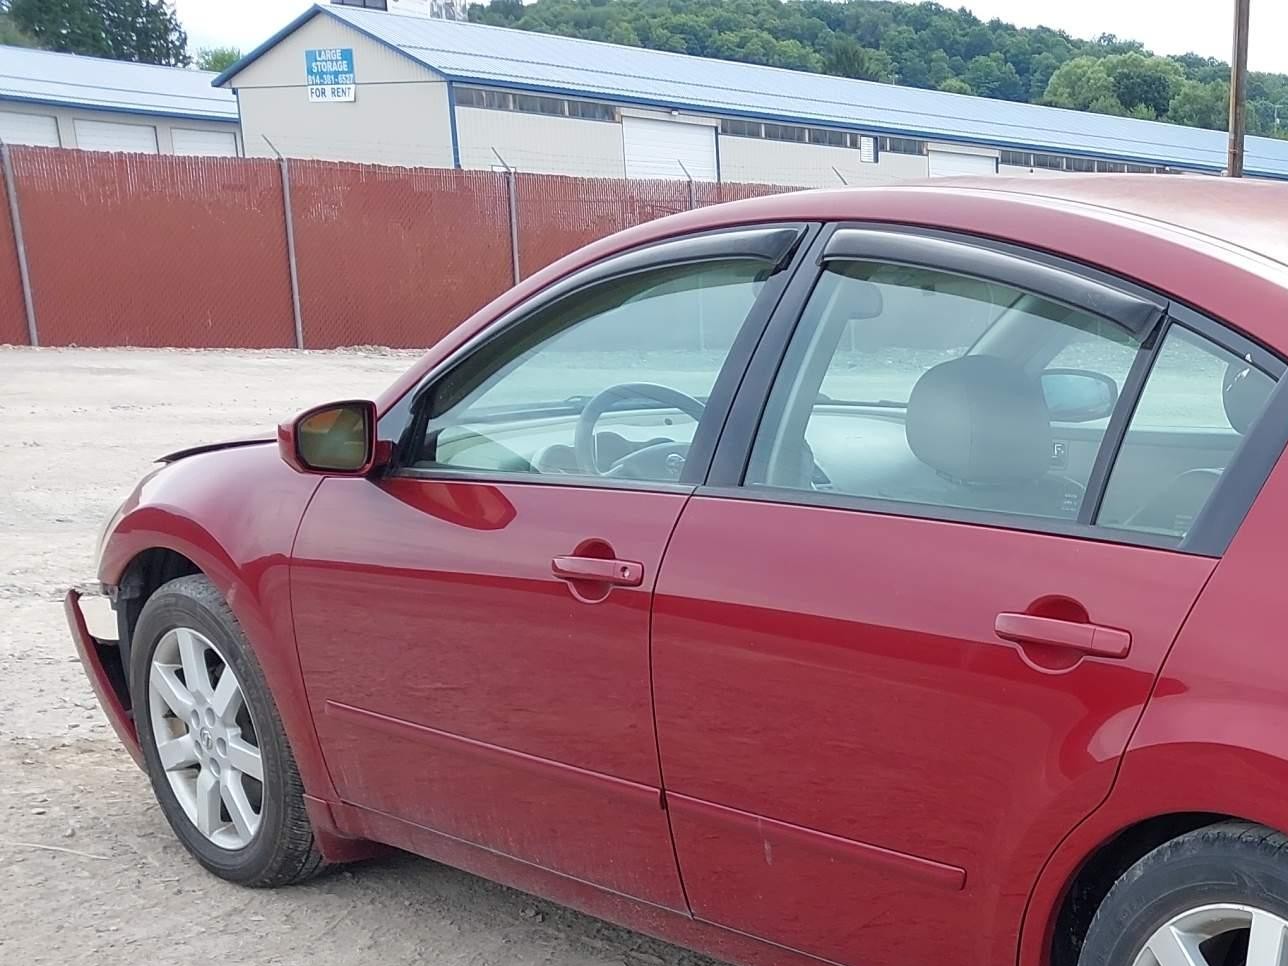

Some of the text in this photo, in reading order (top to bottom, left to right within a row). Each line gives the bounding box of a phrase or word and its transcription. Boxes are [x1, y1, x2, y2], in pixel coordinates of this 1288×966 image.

[316, 49, 342, 60] LARGE
[312, 60, 348, 72] STORAGE
[310, 87, 351, 98] FOR RENT
